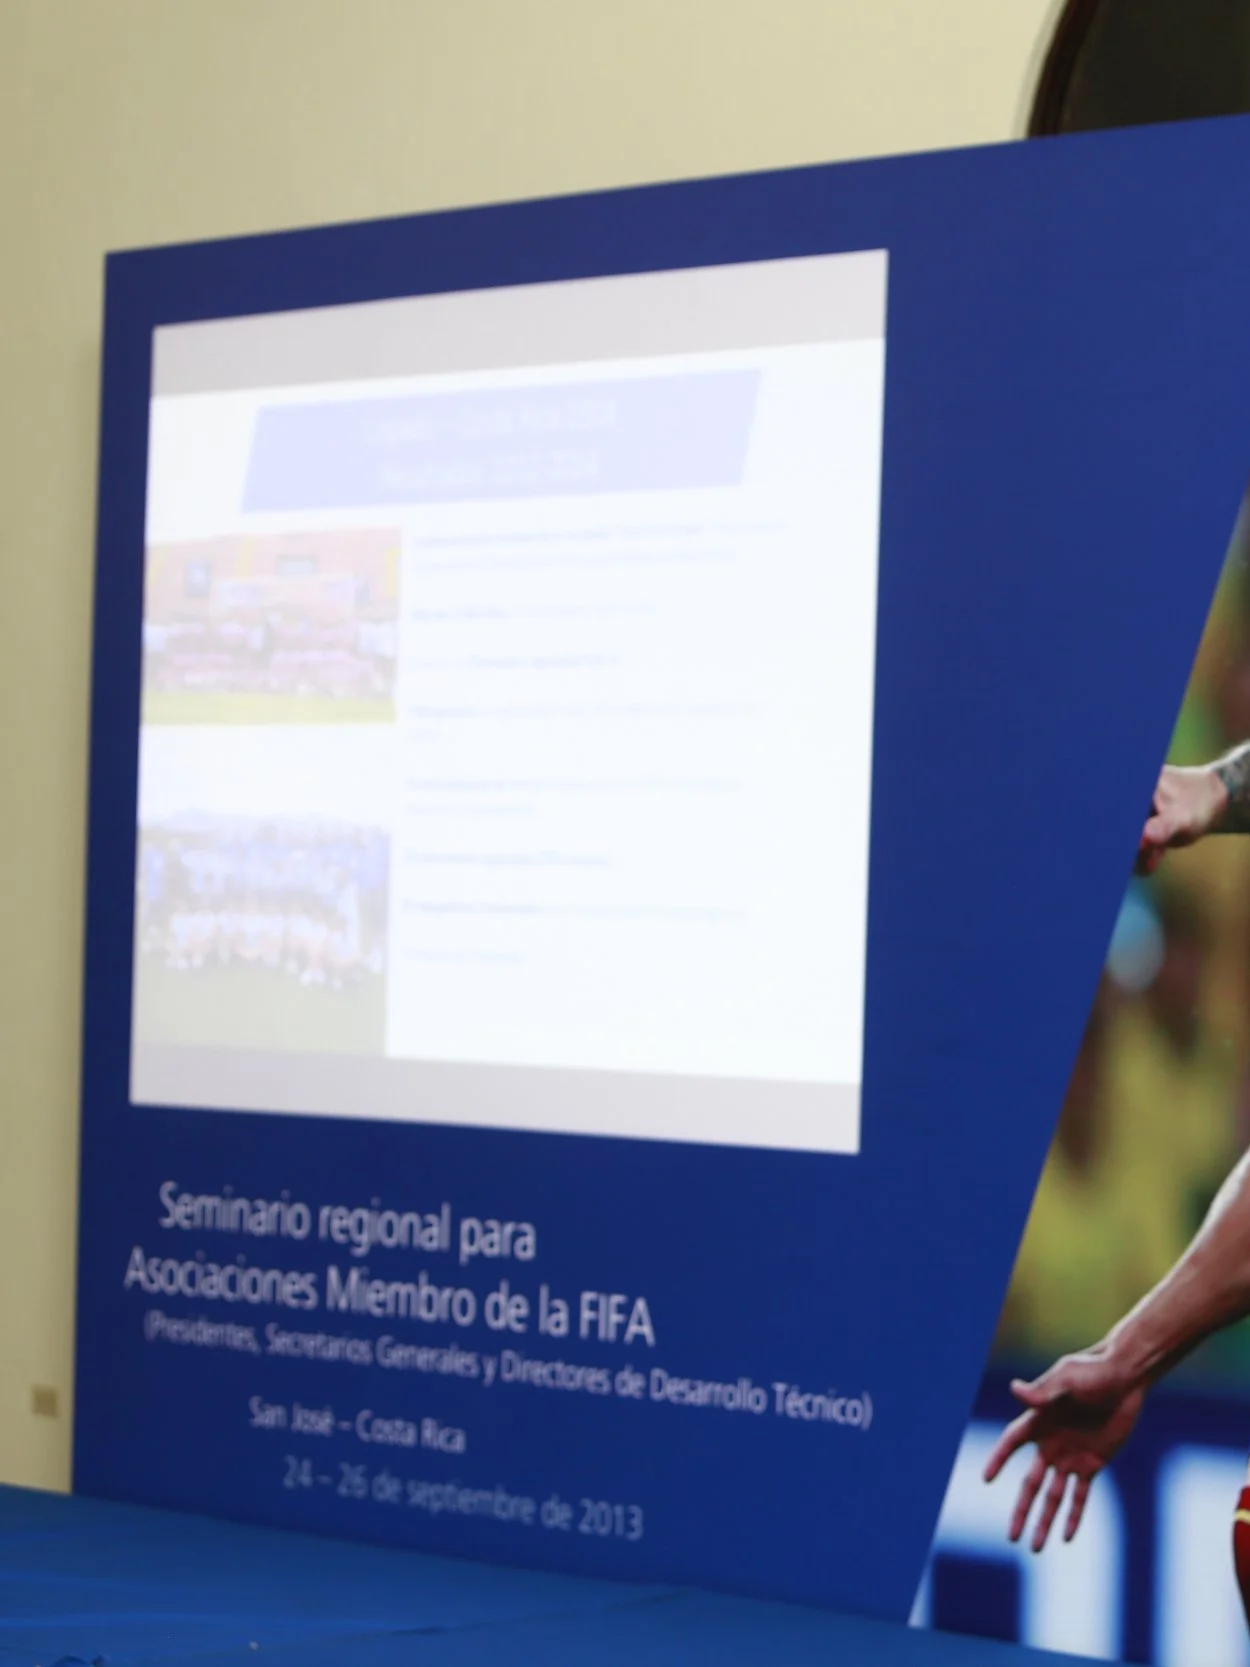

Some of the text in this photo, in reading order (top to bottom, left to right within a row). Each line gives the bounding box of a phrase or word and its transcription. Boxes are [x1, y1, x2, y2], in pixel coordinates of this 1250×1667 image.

[159, 1181, 536, 1267] Seminario regional para
[123, 1245, 655, 1347] Asociaciones Miembro de la FIFA
[144, 1308, 873, 1430] (Presidentes, Secretarios Generales y Directores de Desarrollo Técnico)
[249, 1396, 287, 1429] San
[291, 1402, 335, 1437] José
[355, 1409, 418, 1447] Costa
[420, 1416, 466, 1453] Rica
[283, 1454, 313, 1489] 24
[337, 1463, 368, 1498] 26
[371, 1468, 401, 1503] de
[406, 1477, 537, 1525] septiembre
[540, 1493, 573, 1531] de
[578, 1497, 644, 1541] 2013
